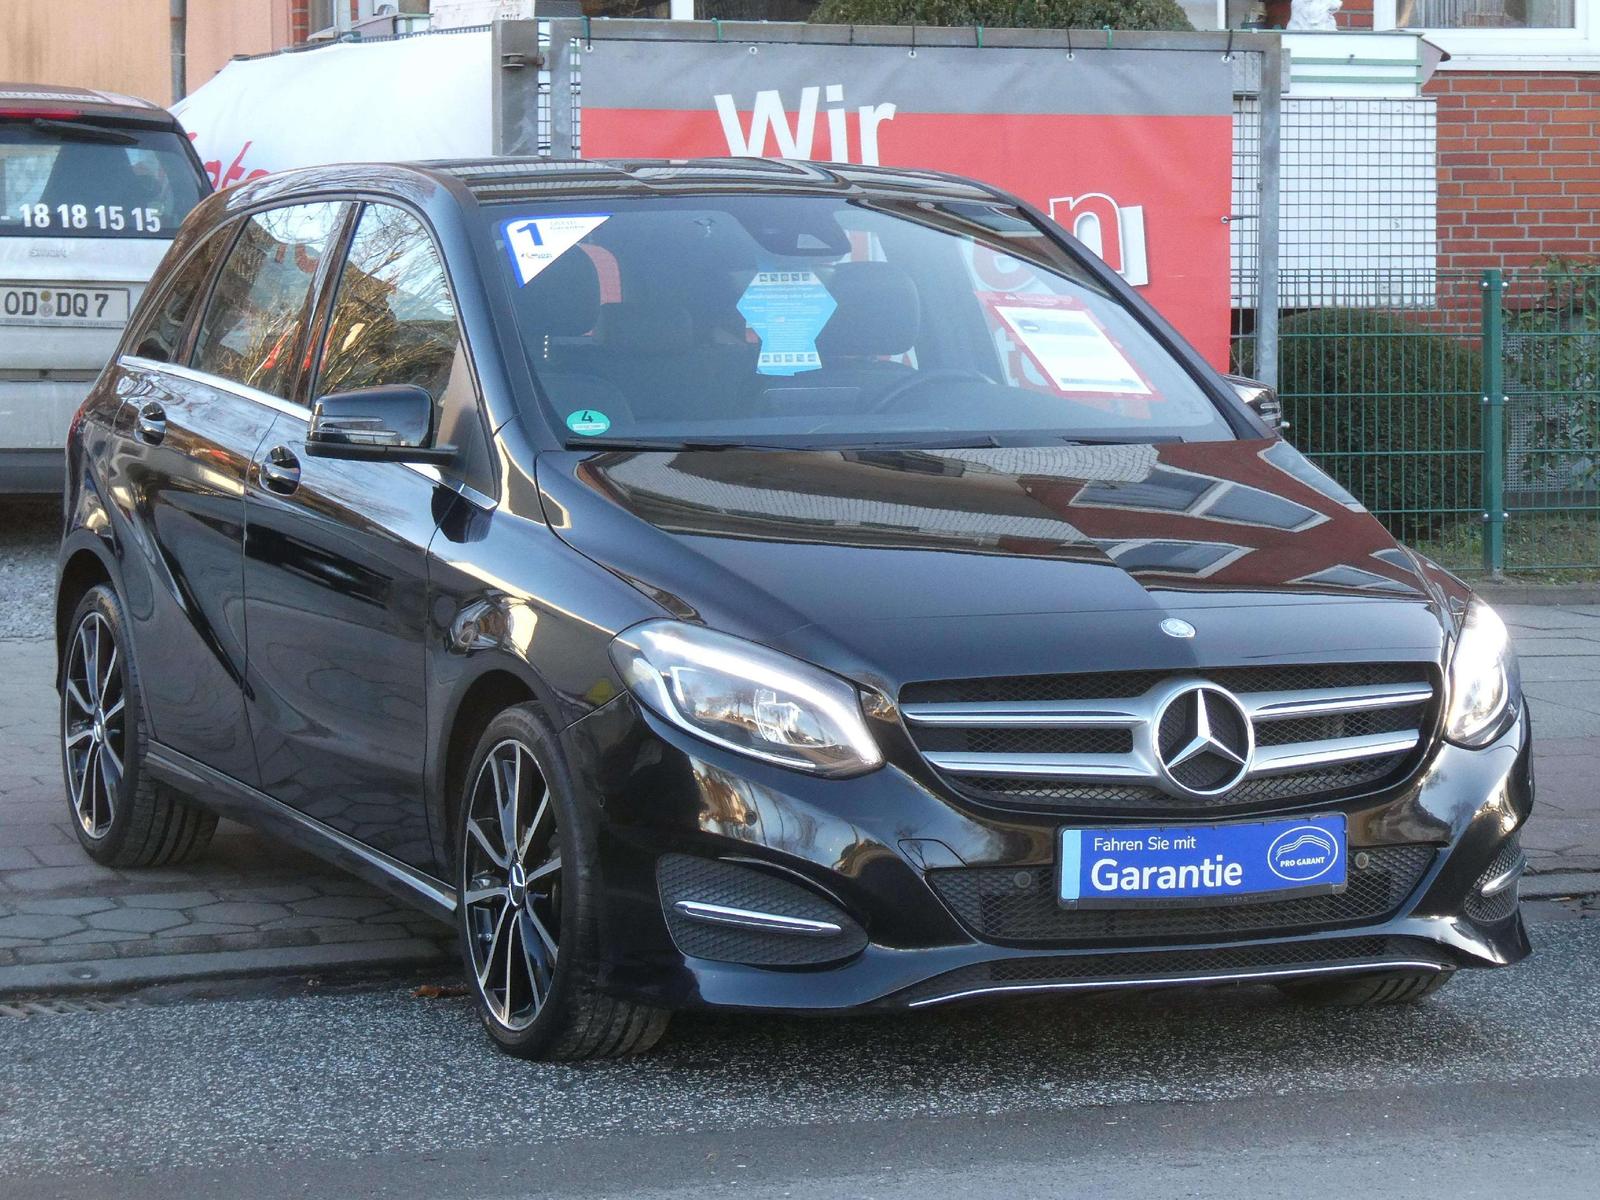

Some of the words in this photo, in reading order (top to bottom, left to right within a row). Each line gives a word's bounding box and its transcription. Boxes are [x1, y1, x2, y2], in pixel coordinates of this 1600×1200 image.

[713, 84, 897, 167] Wir
[20, 203, 51, 228] 18
[57, 204, 88, 229] 18
[95, 205, 125, 231] 15
[131, 207, 161, 233] 15
[516, 222, 544, 246] 1
[4, 291, 38, 316] OD
[56, 292, 89, 318] DQ
[95, 293, 109, 318] 7
[581, 410, 594, 423] 4
[1093, 837, 1143, 851] Fahren
[1147, 836, 1170, 851] Sie
[1173, 836, 1197, 850] mit
[1090, 854, 1243, 891] Garantie
[1279, 859, 1296, 867] PRO
[1296, 856, 1326, 866] GARANT
